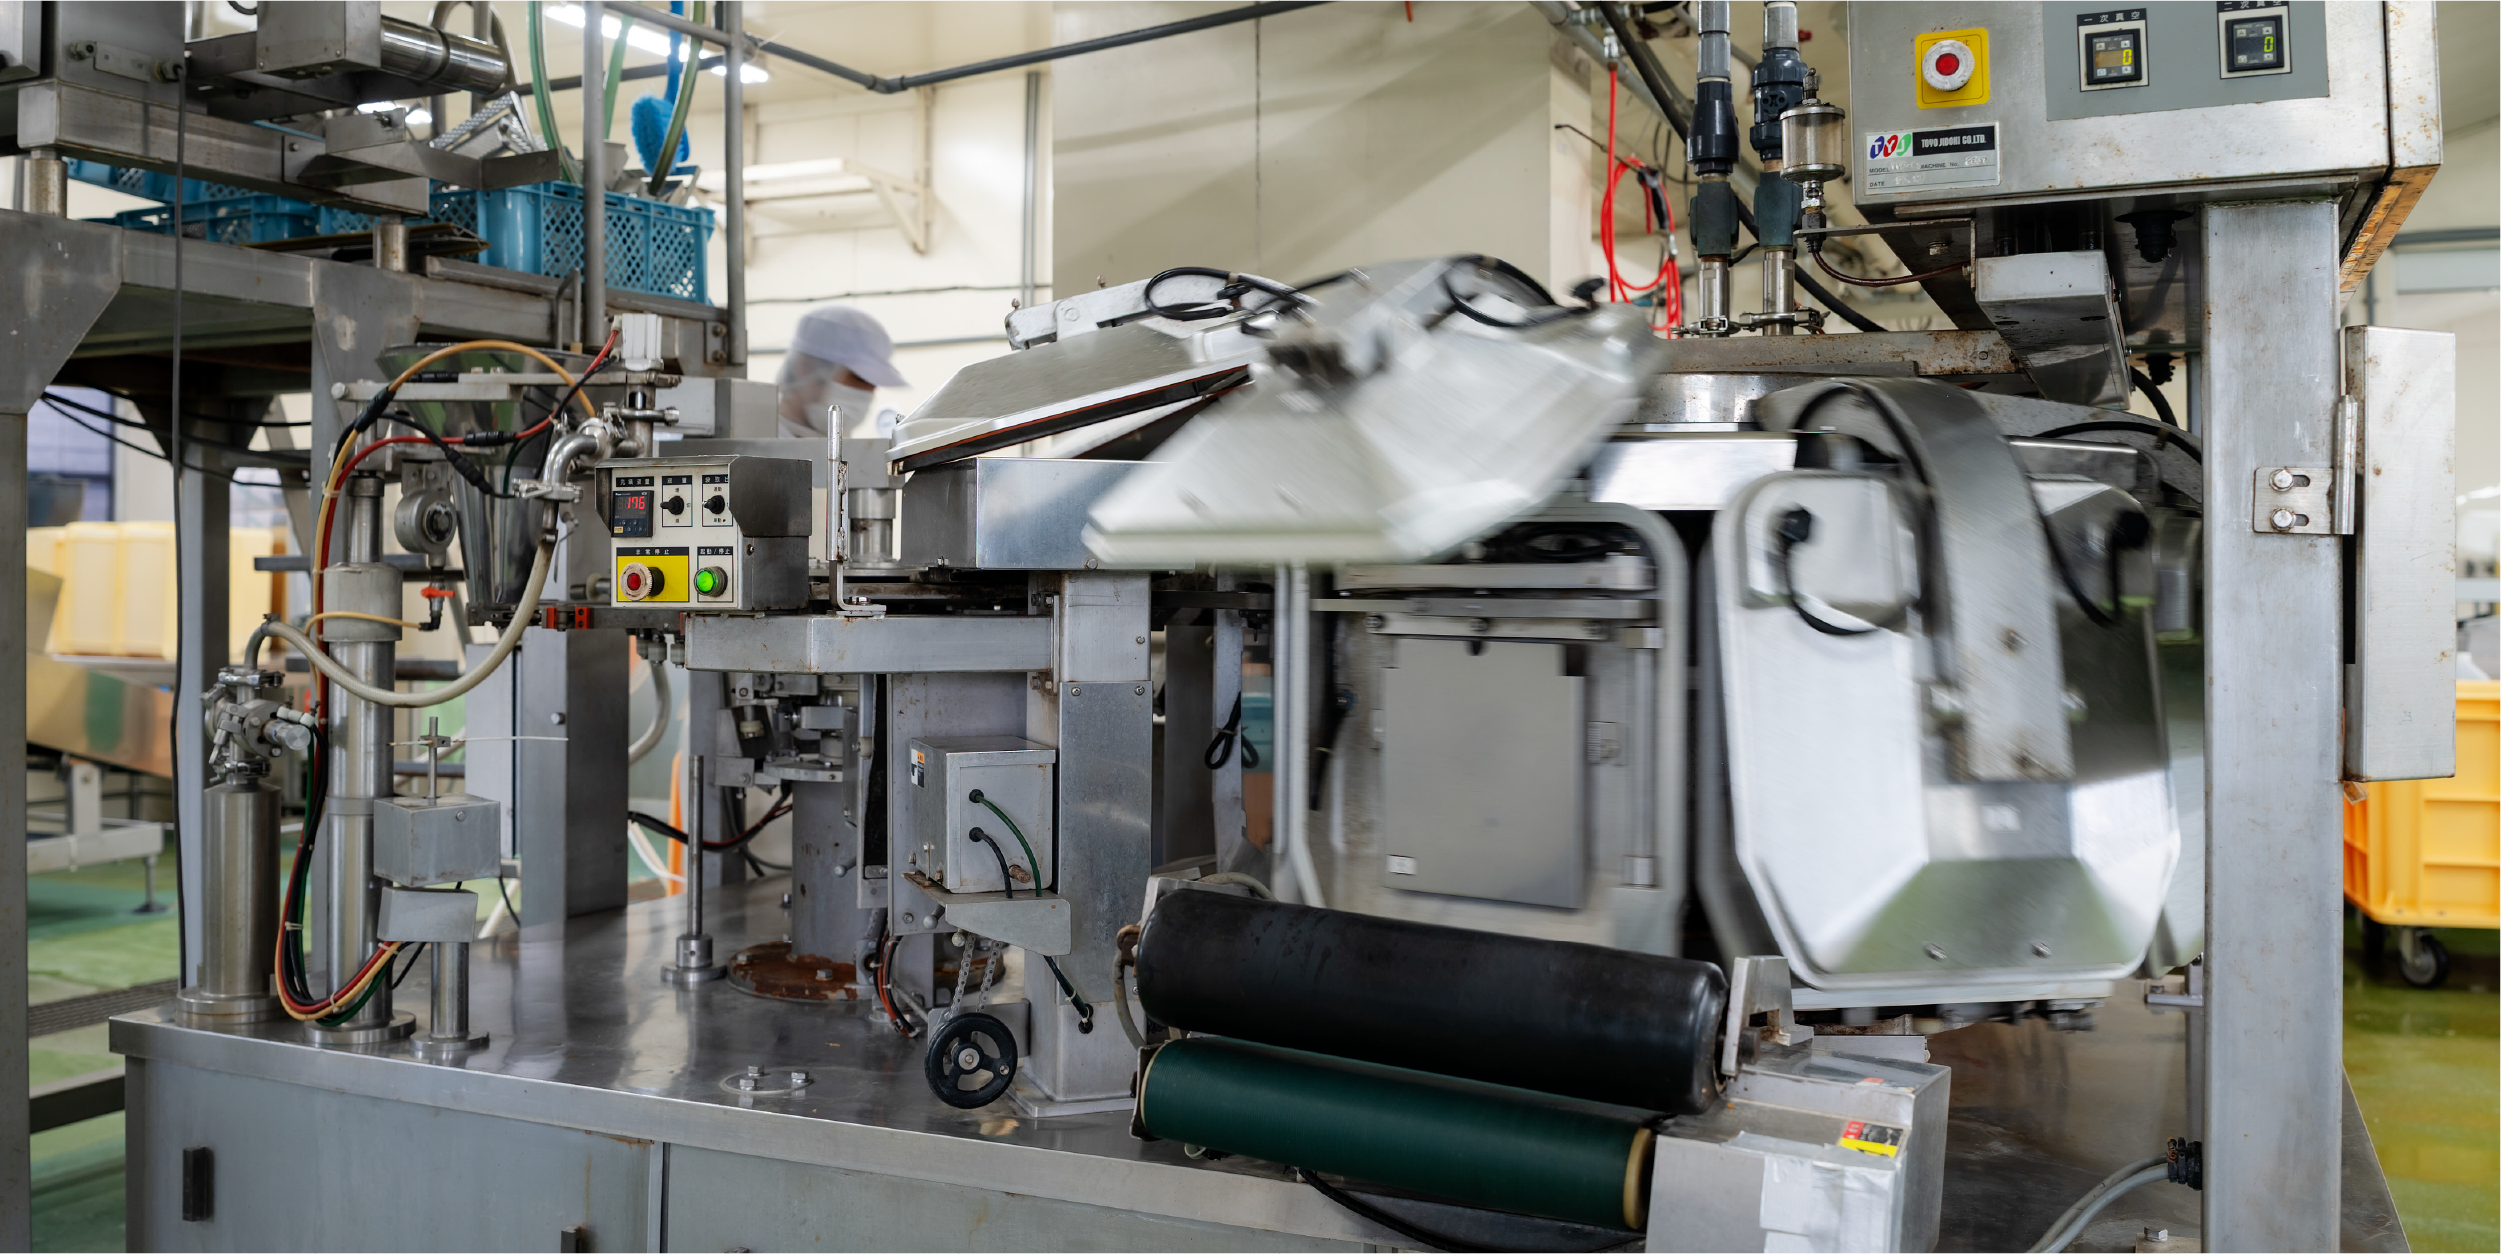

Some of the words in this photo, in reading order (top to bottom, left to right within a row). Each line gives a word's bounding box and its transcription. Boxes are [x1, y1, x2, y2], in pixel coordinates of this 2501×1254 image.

[2263, 36, 2274, 53] 0
[2122, 48, 2133, 66] 0
[1870, 133, 1912, 159] TYJ
[1921, 139, 1939, 148] TOYO
[1939, 136, 1961, 147] JIDOKI
[627, 496, 646, 510] 176
